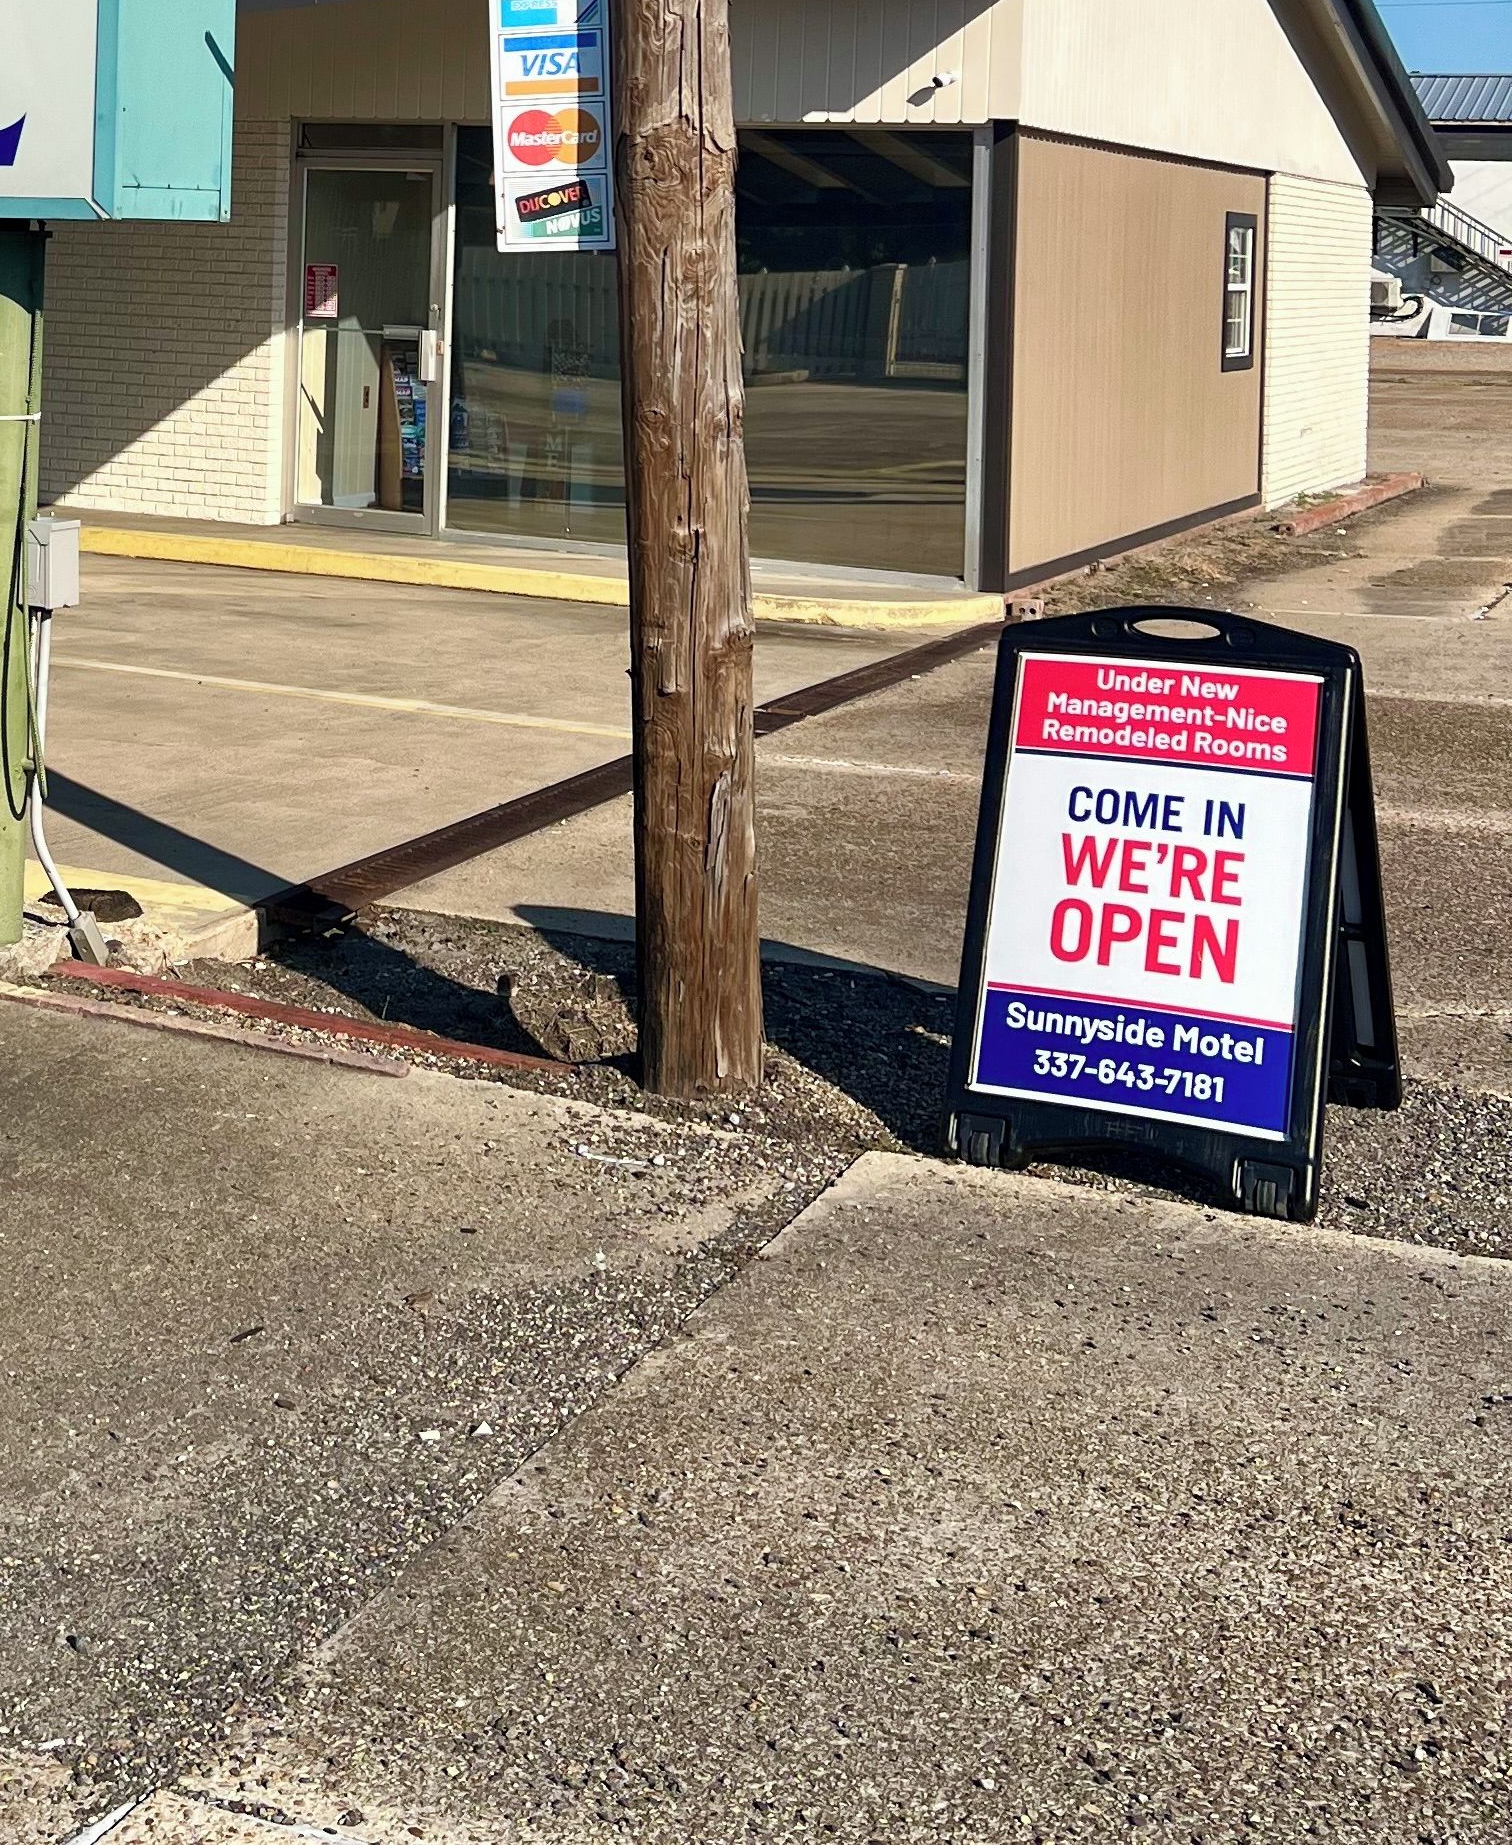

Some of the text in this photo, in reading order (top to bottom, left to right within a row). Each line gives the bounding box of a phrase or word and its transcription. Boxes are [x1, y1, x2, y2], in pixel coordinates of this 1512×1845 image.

[512, 0, 559, 11] EXPRESS
[520, 52, 581, 76] VISA
[510, 130, 598, 147] MasterCard
[545, 208, 601, 234] NOVUS
[1096, 668, 1239, 701] Under New
[1047, 691, 1288, 734] Management-Nice
[1042, 718, 1288, 763] Remodeled Rooms
[1068, 786, 1245, 840] COME IN
[1061, 833, 1245, 906] WE'RE
[1050, 898, 1239, 984] OPEN
[1006, 1001, 1264, 1066] Sunnyside Motel
[1033, 1049, 1224, 1103] 337-643-7181
